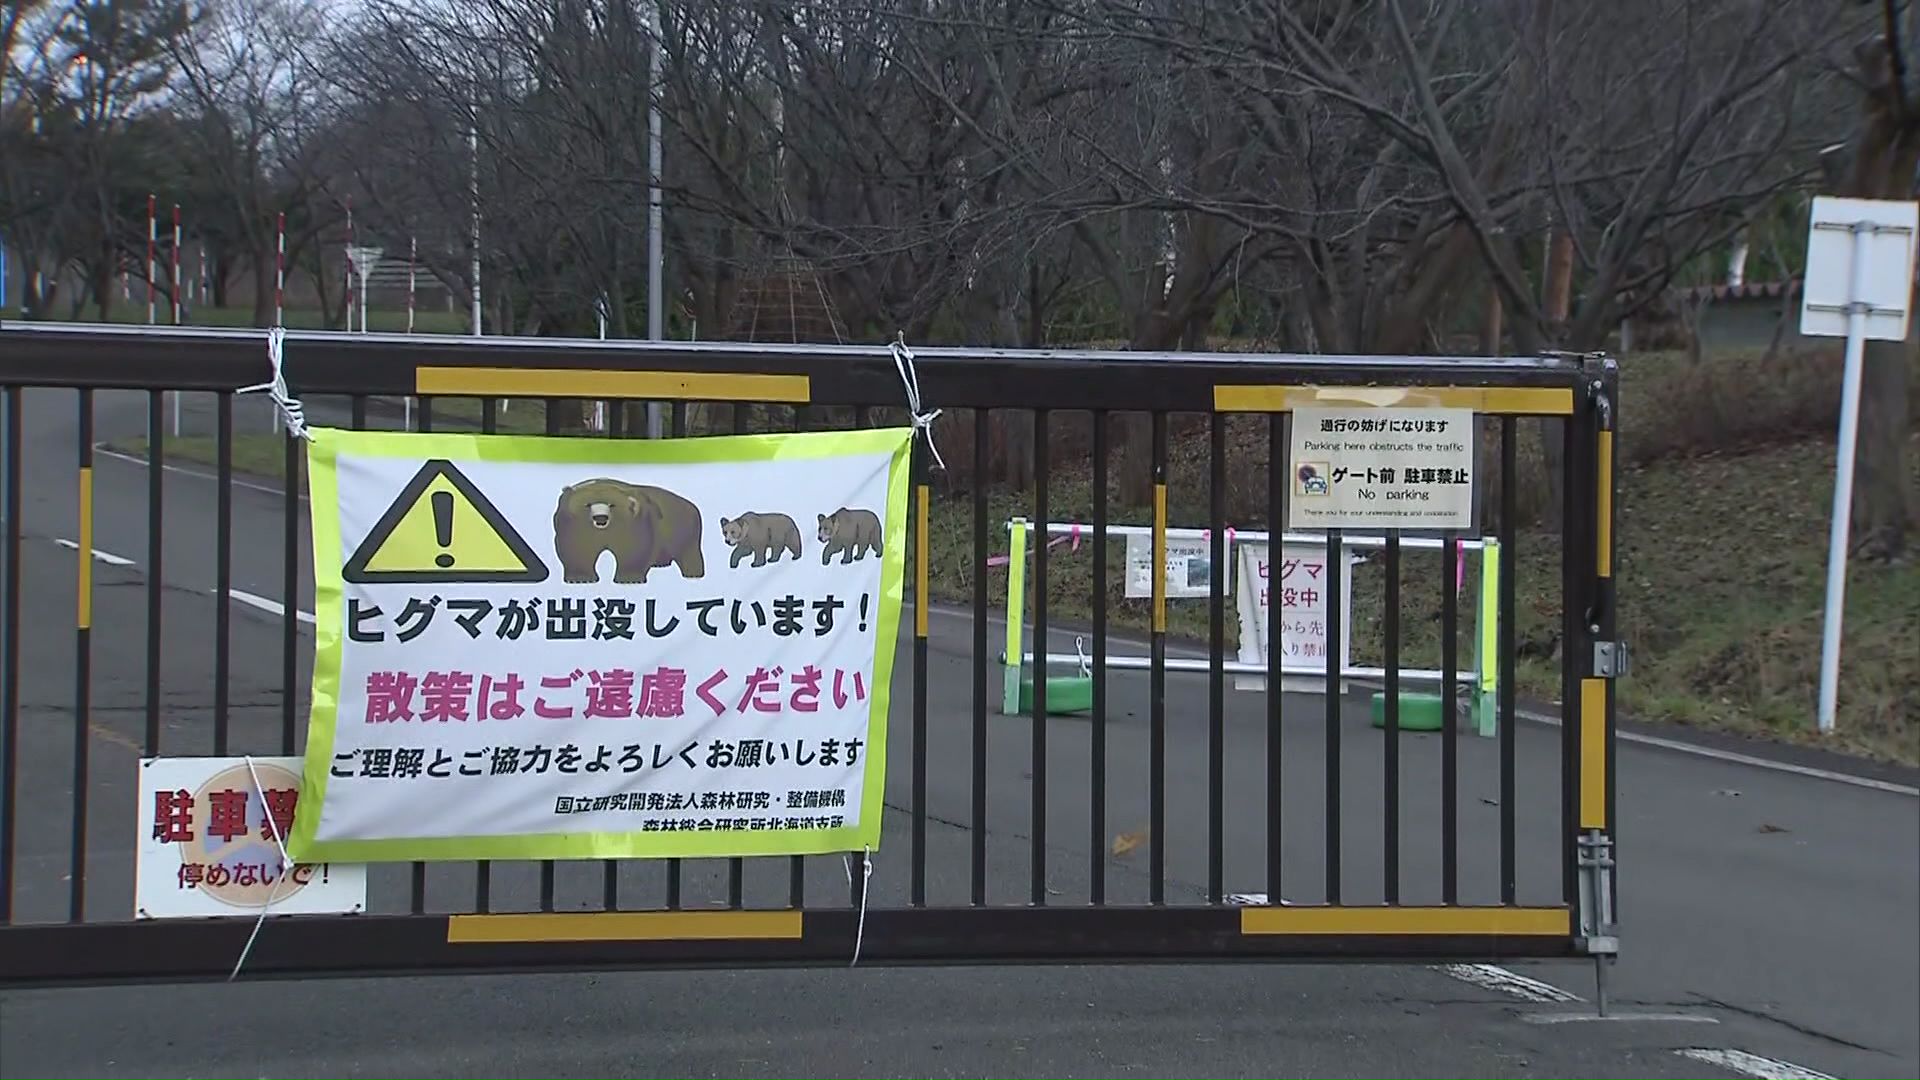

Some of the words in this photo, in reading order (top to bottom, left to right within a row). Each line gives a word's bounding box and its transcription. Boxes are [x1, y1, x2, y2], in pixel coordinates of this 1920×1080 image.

[1320, 419, 1449, 433] 通行の妨げになります
[1304, 441, 1341, 452] Parking
[1344, 442, 1366, 451] here
[1369, 442, 1414, 451] obstructs
[1417, 442, 1433, 451] the
[1436, 442, 1464, 452] traffic
[1332, 467, 1395, 484] ゲート前
[1404, 467, 1470, 484] 駐車禁止
[1358, 489, 1376, 500] No
[1386, 489, 1430, 501] parking
[346, 593, 870, 644] ヒグマが出没しています！
[365, 664, 867, 724] 散策はご遠慮ください
[330, 737, 865, 778] ご理解とご協力をよろしくお願いします
[555, 789, 846, 815] 国立研究開発法人森林研究・整備機構
[152, 788, 300, 844] 駐車禁
[178, 862, 329, 889] 停めないで！
